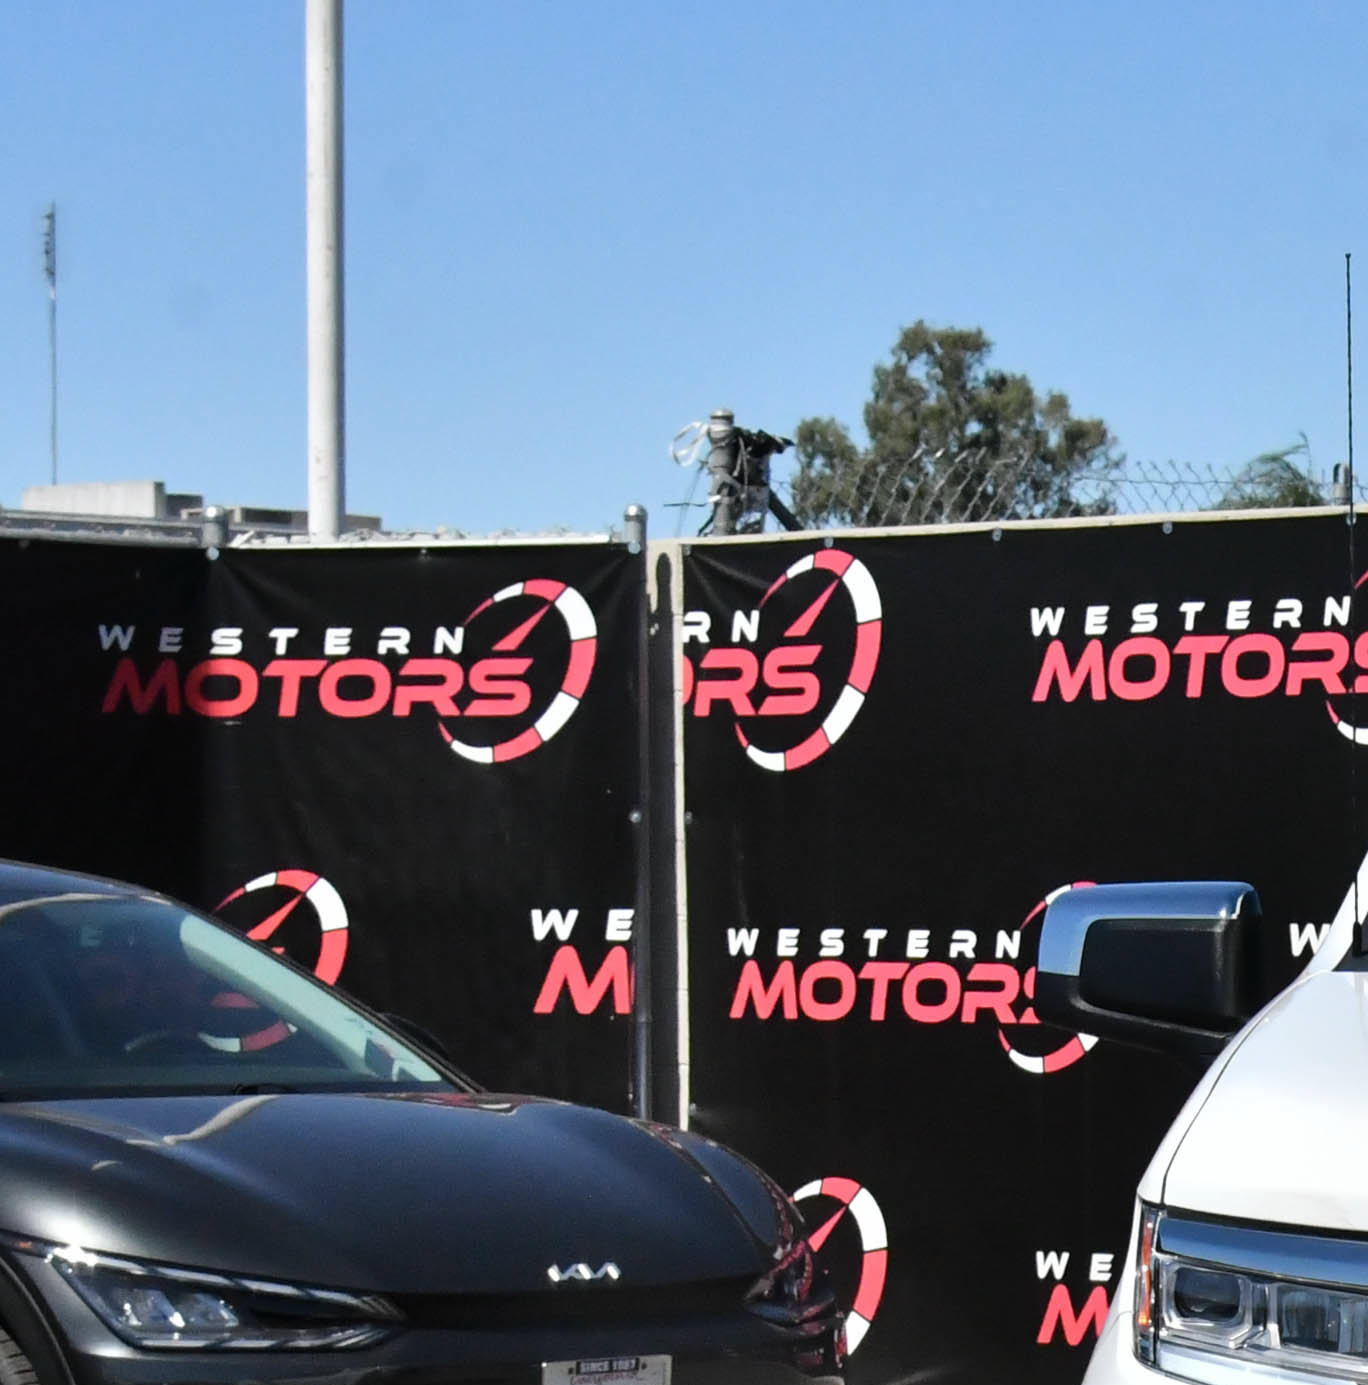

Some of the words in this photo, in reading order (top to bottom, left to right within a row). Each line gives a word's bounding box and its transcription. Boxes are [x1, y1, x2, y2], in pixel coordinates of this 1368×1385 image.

[1030, 595, 1352, 637] WESTERN
[97, 623, 465, 656] WESTERN
[100, 656, 534, 719] MOTORS
[682, 644, 823, 718] RS
[727, 927, 1022, 960] WESTERN
